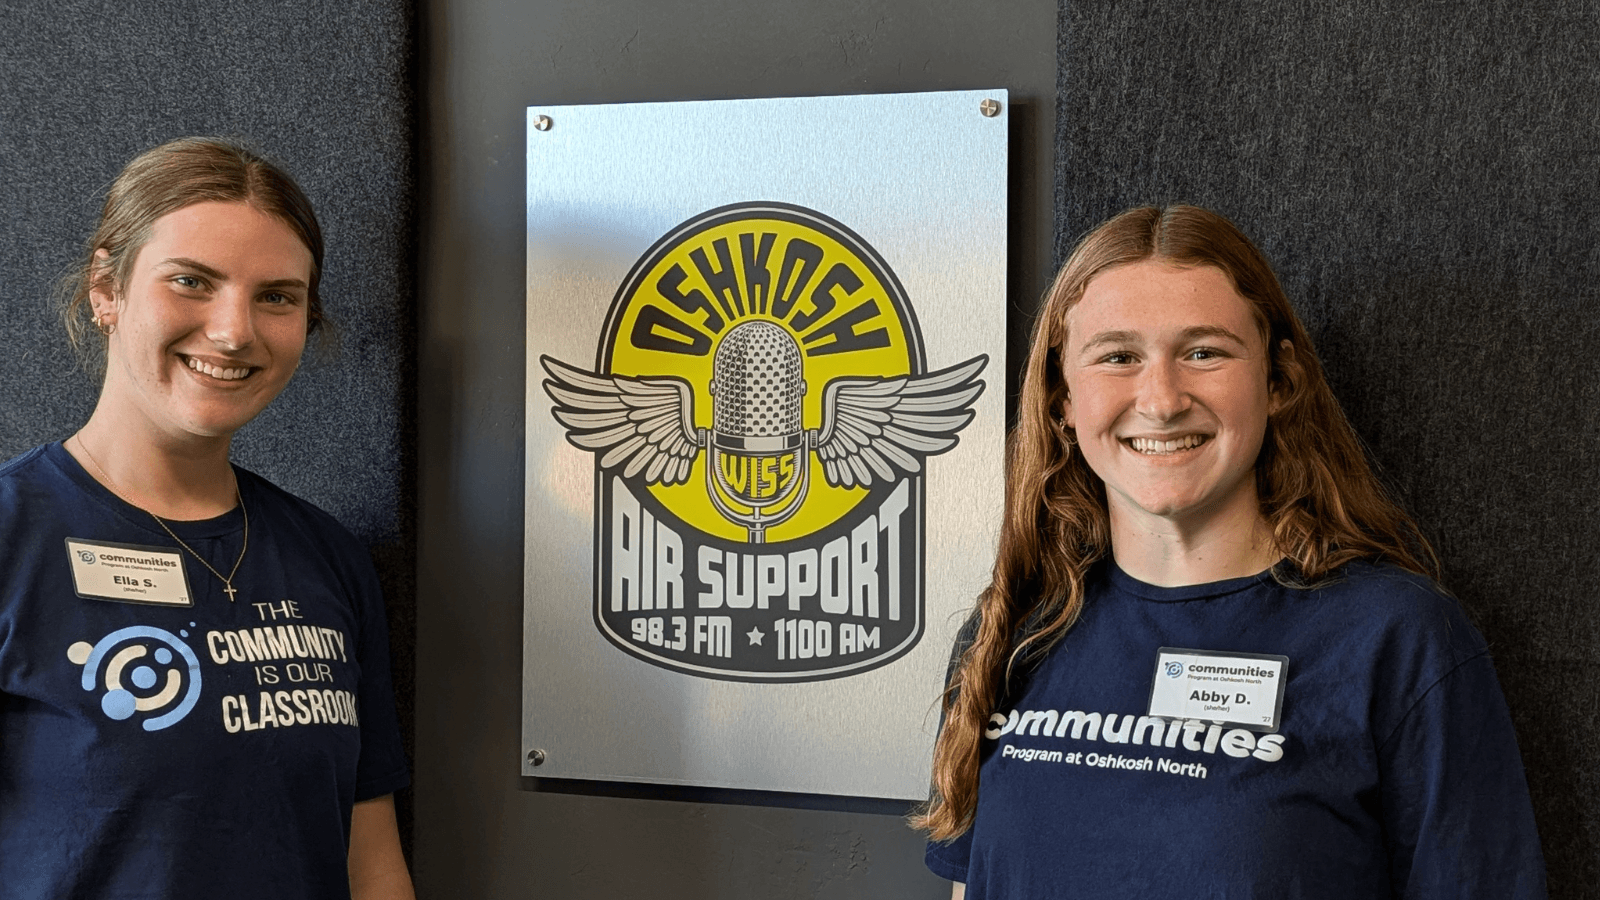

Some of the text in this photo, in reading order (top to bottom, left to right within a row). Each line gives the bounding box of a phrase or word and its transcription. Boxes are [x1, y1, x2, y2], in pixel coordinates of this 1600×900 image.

[630, 232, 891, 356] OSHKOSH
[720, 452, 795, 498] WISS
[99, 553, 177, 568] communities
[611, 475, 909, 621] AIR SUPPORT
[113, 575, 157, 588] Ella S.
[252, 600, 303, 621] THE
[206, 625, 347, 665] COMMUNITY
[631, 616, 880, 660] 98.3 FM 1100 AM
[255, 662, 333, 685] IS OUR
[1188, 665, 1275, 678] communities
[222, 689, 359, 734] CLASSROOM
[1189, 690, 1251, 706] Abby D.
[1002, 744, 1207, 779] Program at Oshkosh North
